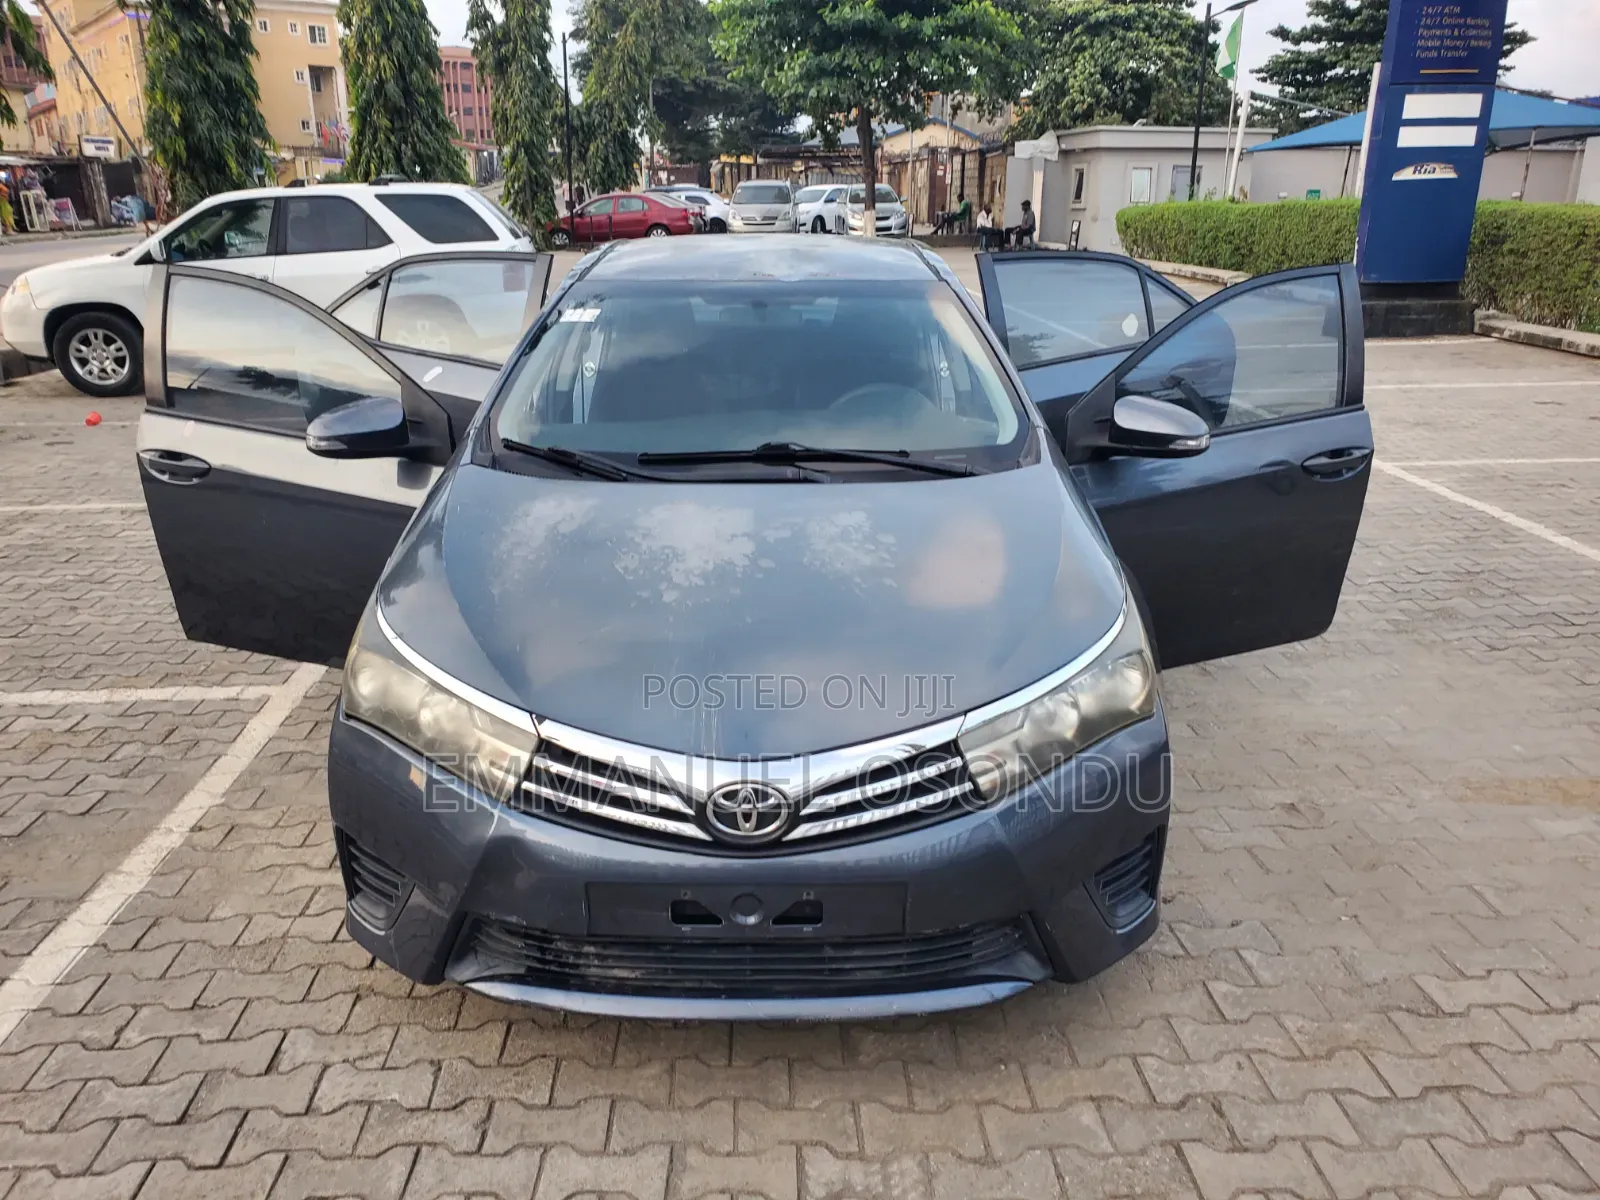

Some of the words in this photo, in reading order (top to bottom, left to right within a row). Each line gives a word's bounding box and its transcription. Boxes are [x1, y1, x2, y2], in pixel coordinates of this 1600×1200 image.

[1422, 6, 1442, 14] 24/7
[1444, 6, 1460, 14] ATM
[1420, 17, 1440, 26] 24/7
[1442, 16, 1465, 24] Online
[1466, 17, 1490, 27] Banking
[1418, 28, 1451, 37] Payments
[1460, 28, 1492, 36] Collections
[1417, 39, 1441, 47] Mobile
[1443, 39, 1464, 48] Money
[1416, 50, 1438, 58] Funds
[1440, 49, 1469, 57] Transfer
[1412, 164, 1436, 175] Ria
